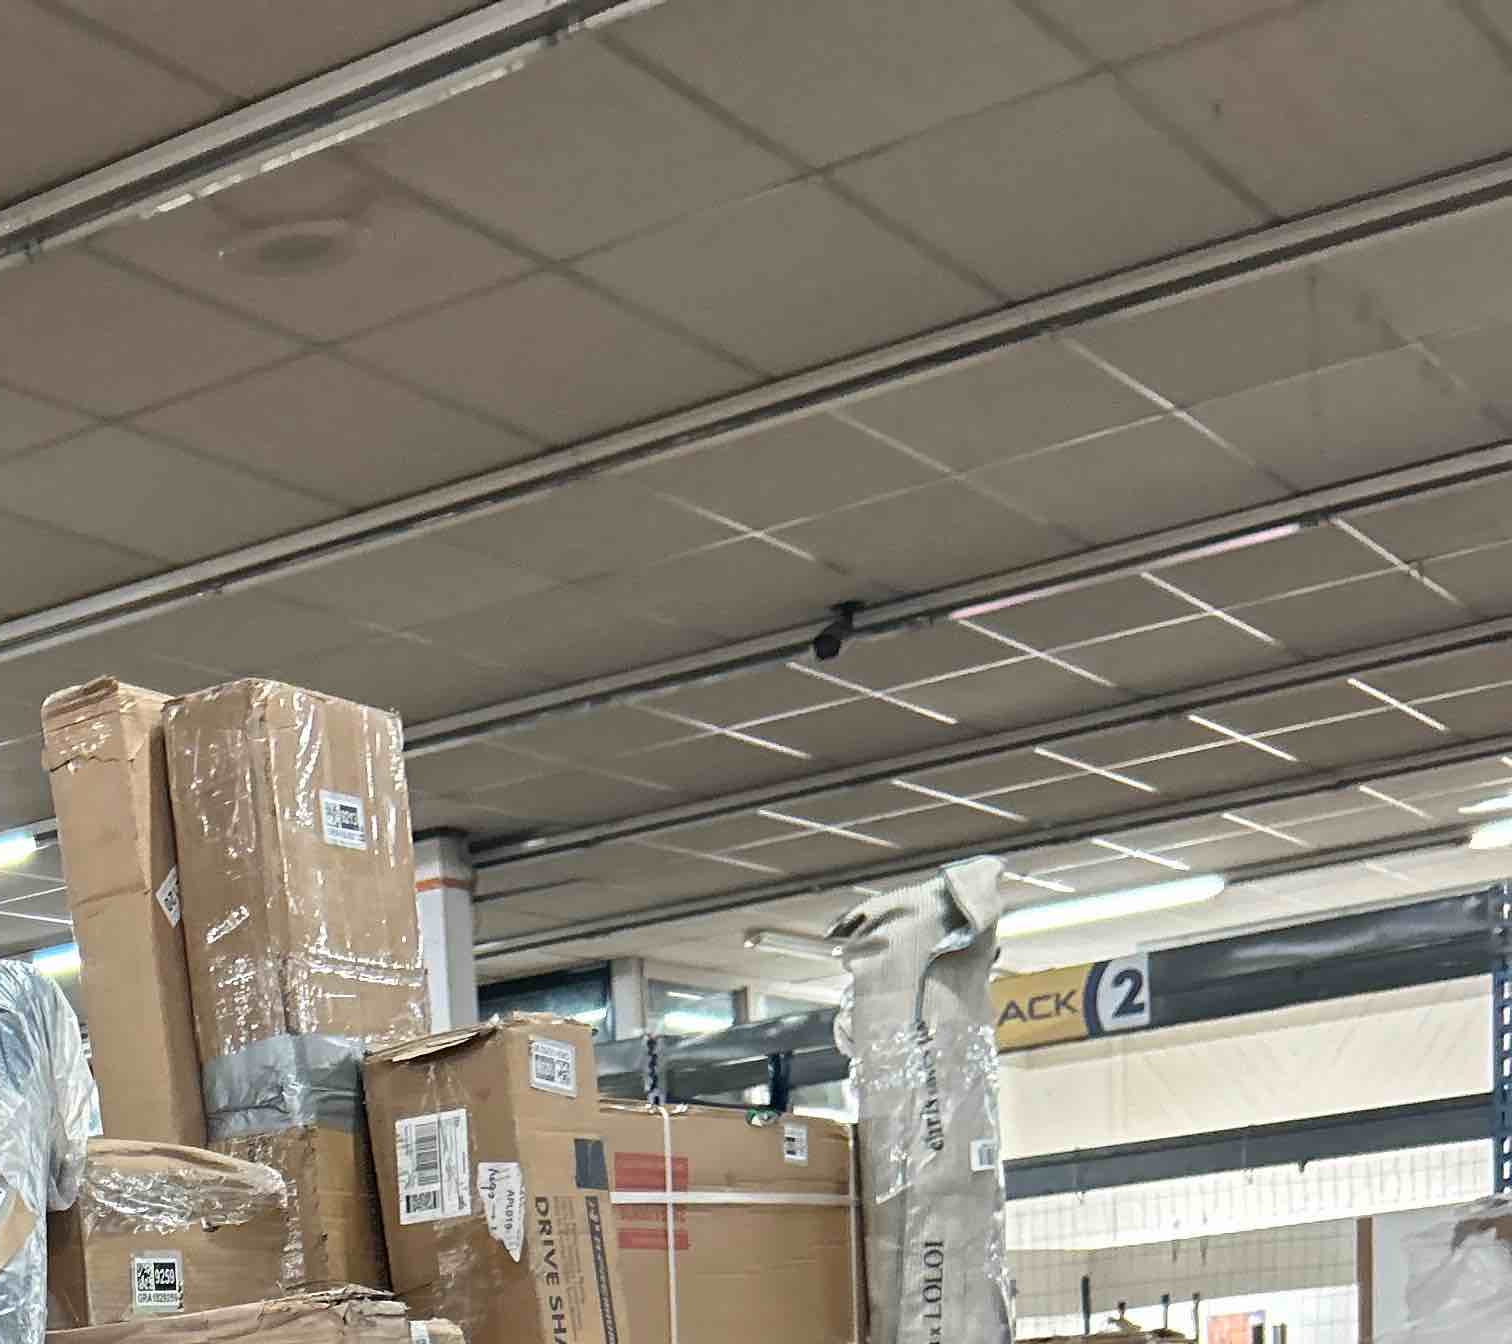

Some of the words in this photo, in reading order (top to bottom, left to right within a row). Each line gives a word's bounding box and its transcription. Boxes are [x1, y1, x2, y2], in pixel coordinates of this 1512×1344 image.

[998, 989, 1078, 1026] ACK
[1111, 968, 1145, 1018] 2
[535, 1196, 561, 1287] DRIVE
